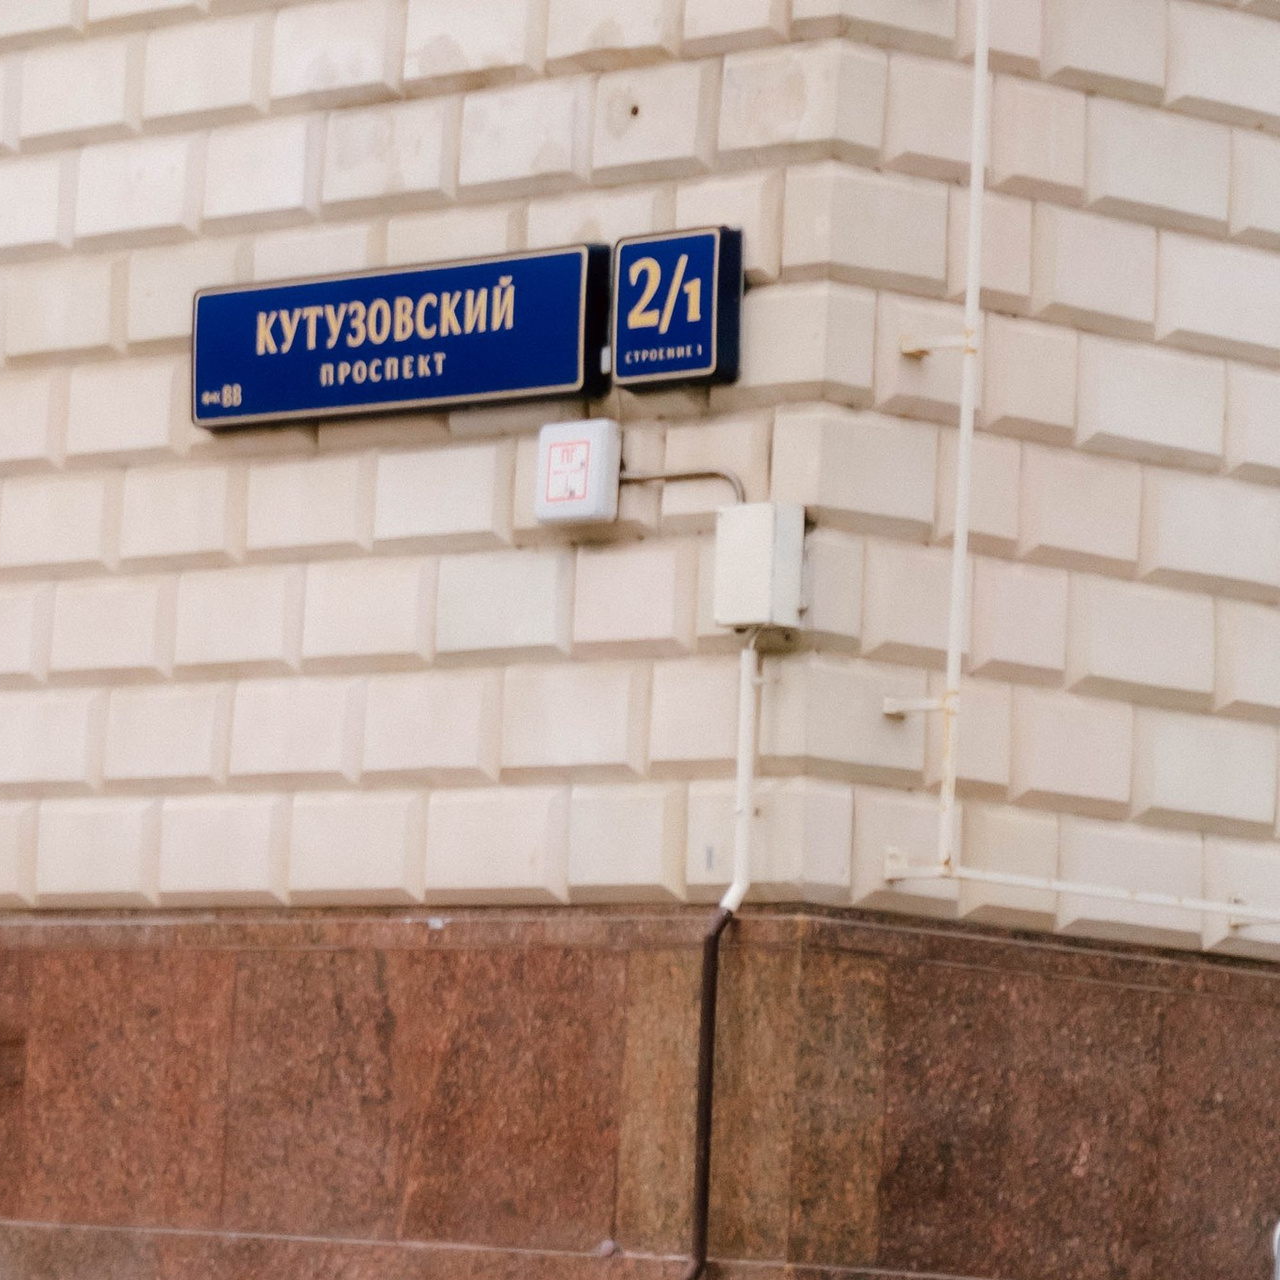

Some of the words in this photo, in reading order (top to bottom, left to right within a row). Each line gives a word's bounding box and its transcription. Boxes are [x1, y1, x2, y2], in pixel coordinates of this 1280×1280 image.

[254, 275, 516, 356] КУТУЗОВСКИЙ
[626, 253, 702, 335] 2/1
[319, 352, 447, 388] ПРОСПЕКТ
[624, 344, 692, 365] СТРОЕНИЕ
